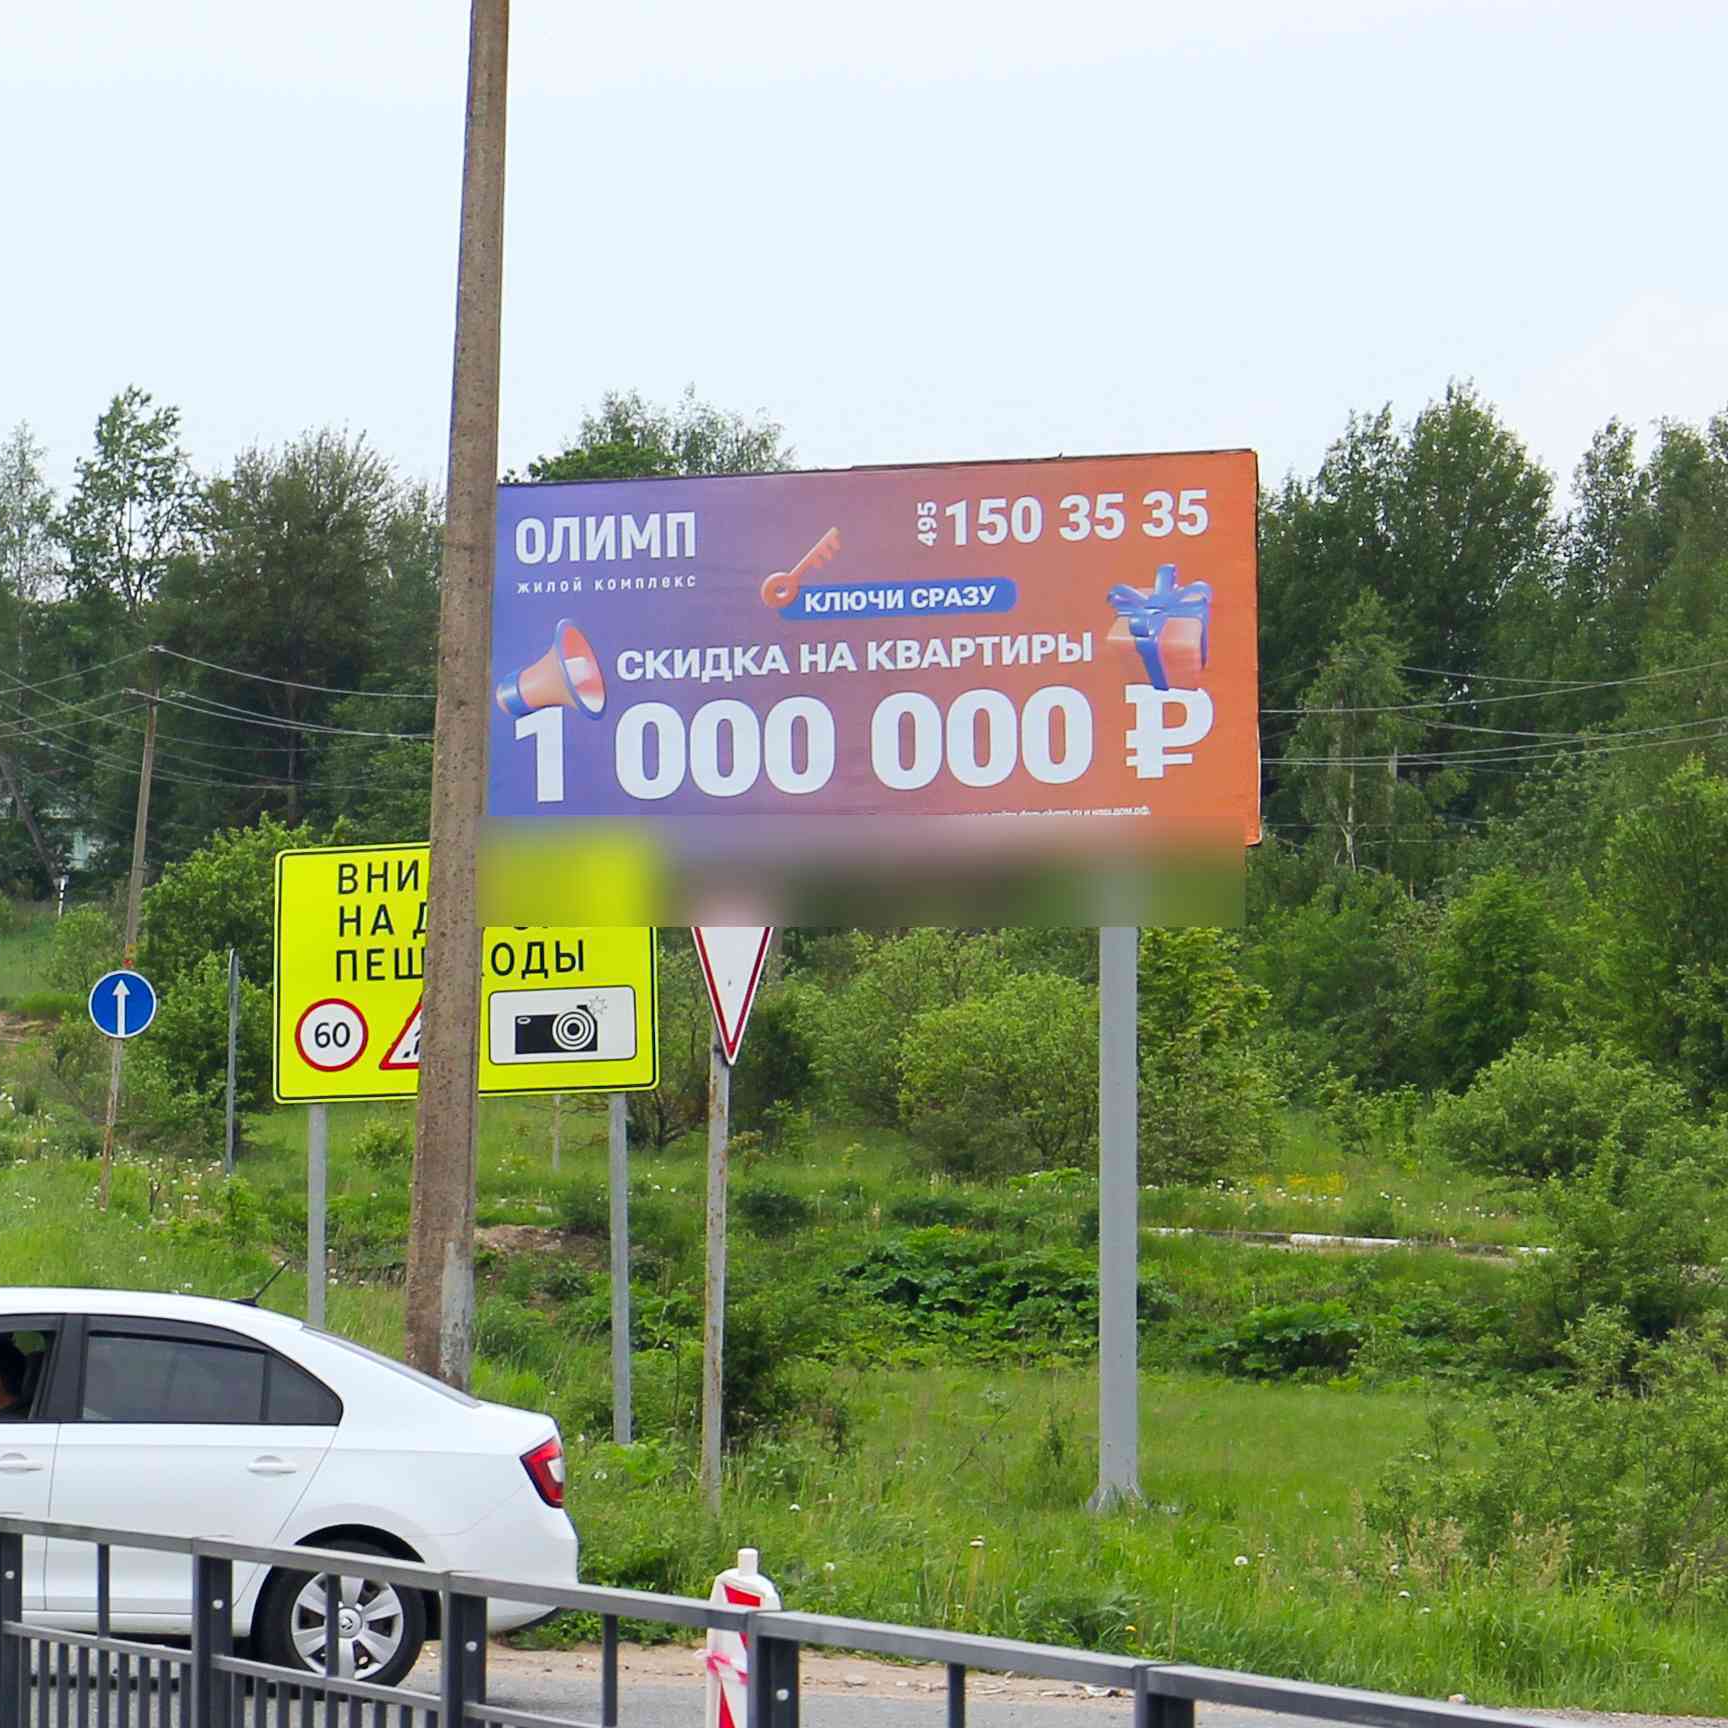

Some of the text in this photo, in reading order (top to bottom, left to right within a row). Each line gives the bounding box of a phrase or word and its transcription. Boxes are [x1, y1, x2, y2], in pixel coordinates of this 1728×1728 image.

[515, 511, 696, 564] ОЛИМП
[917, 489, 1209, 546] 495 150 35 35
[517, 574, 696, 593] жилой комплекс
[804, 585, 996, 612] КЛЮЧИ СРАЗУ
[617, 632, 1093, 682] СКИДКА НА КВАРТИРЫ
[514, 704, 565, 803] 1
[614, 694, 835, 800] 000
[869, 685, 1093, 791] 000
[339, 903, 395, 937] НА
[336, 939, 585, 982] ПЕШОДЫ
[314, 1021, 351, 1048] 60
